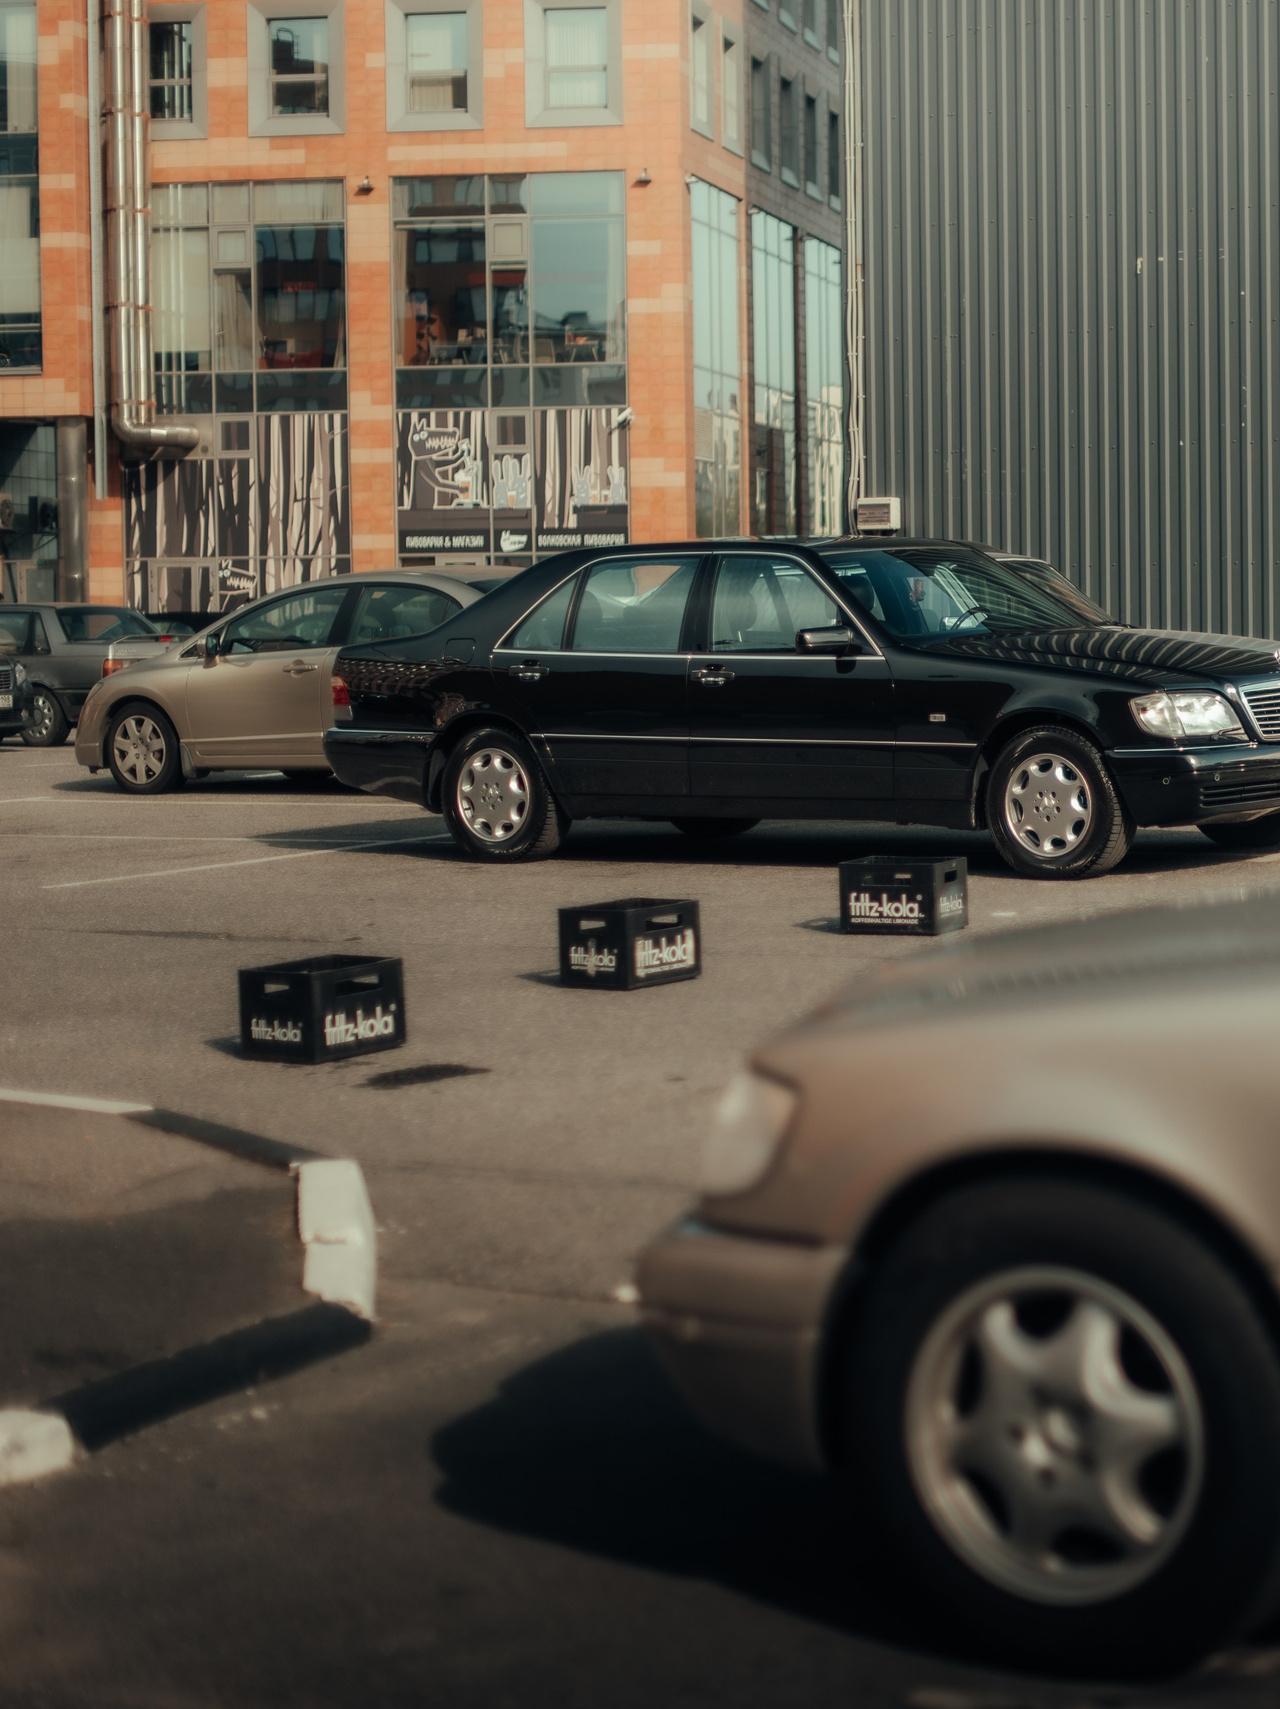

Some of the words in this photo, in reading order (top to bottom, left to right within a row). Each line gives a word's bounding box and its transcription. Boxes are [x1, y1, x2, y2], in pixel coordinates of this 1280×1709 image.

[405, 535, 444, 549] ПИВОВАРНЯ
[444, 535, 451, 548] &
[452, 535, 485, 548] МАГАЗИН
[537, 534, 581, 547] ВОЛКОВСКАЯ
[584, 533, 625, 546] ПИВОВАРНЯ
[849, 892, 919, 917] fritz-kola
[251, 1018, 302, 1042] fritz-kola
[324, 1005, 396, 1046] fritz-kola
